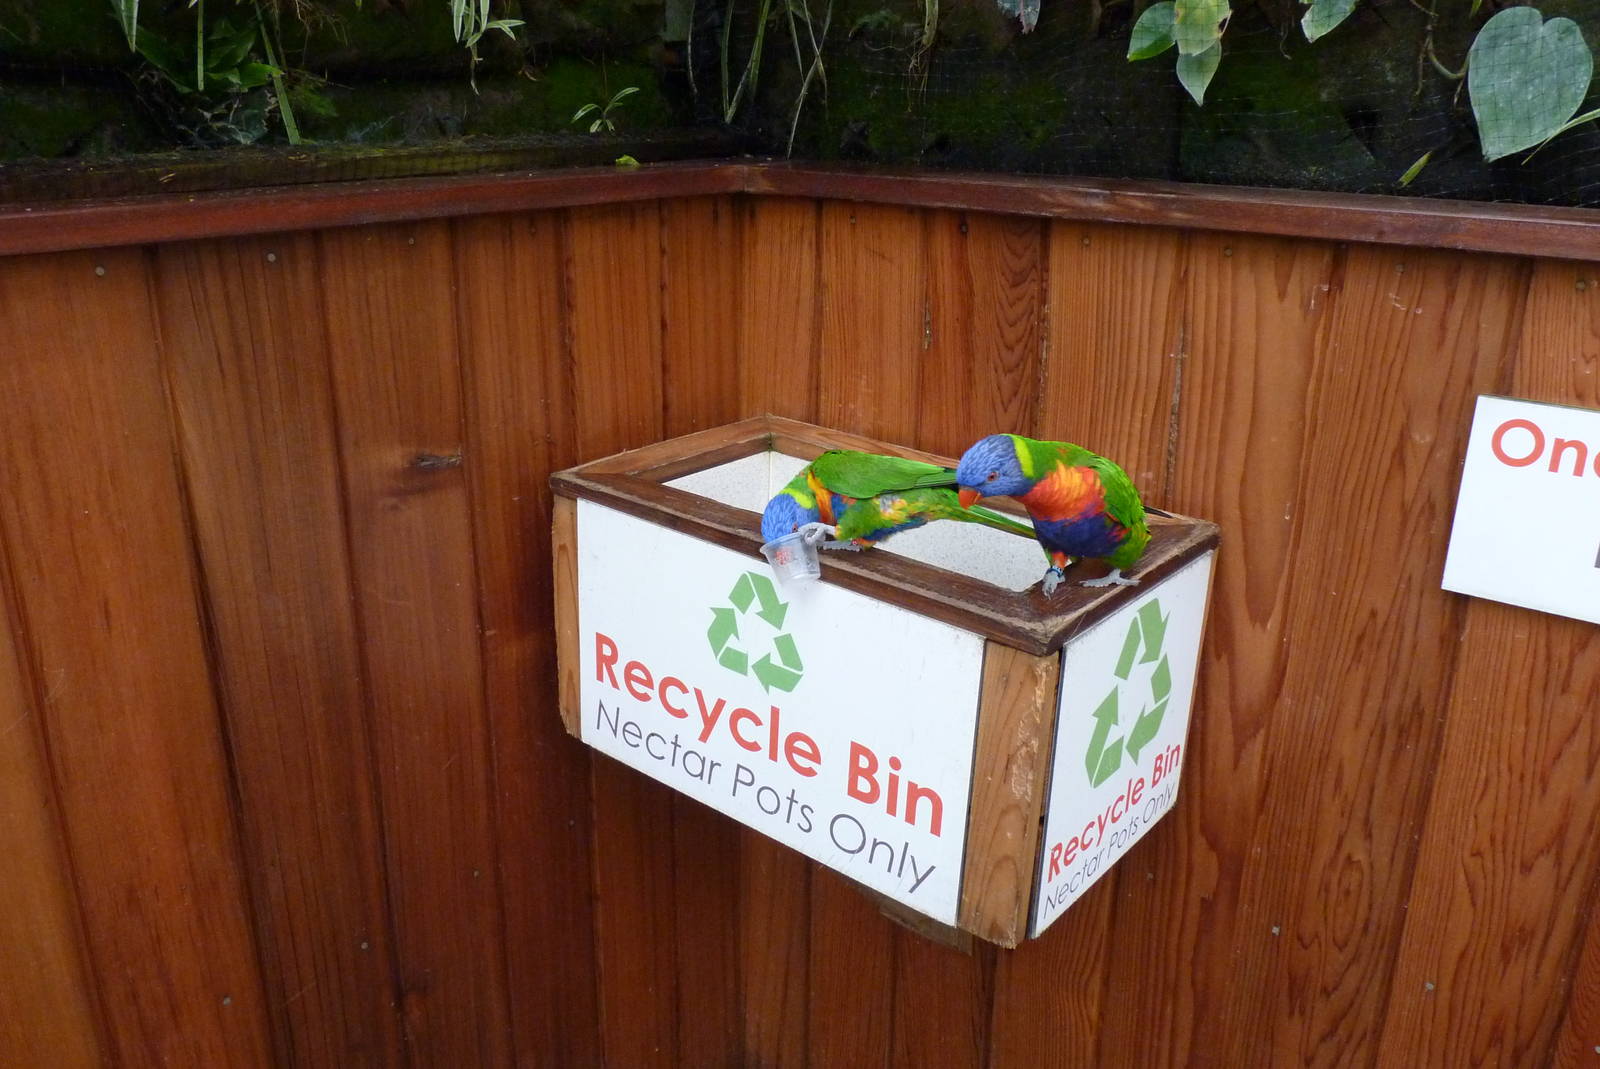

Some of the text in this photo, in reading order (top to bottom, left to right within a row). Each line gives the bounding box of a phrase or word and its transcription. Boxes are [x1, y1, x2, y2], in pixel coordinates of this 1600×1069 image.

[1491, 418, 1600, 478] On
[595, 632, 943, 838] Recycle Bin
[596, 700, 937, 894] Nectar Pots Only
[1043, 781, 1175, 920] Nectar Pots Only
[1048, 744, 1181, 883] Recycle Bin
